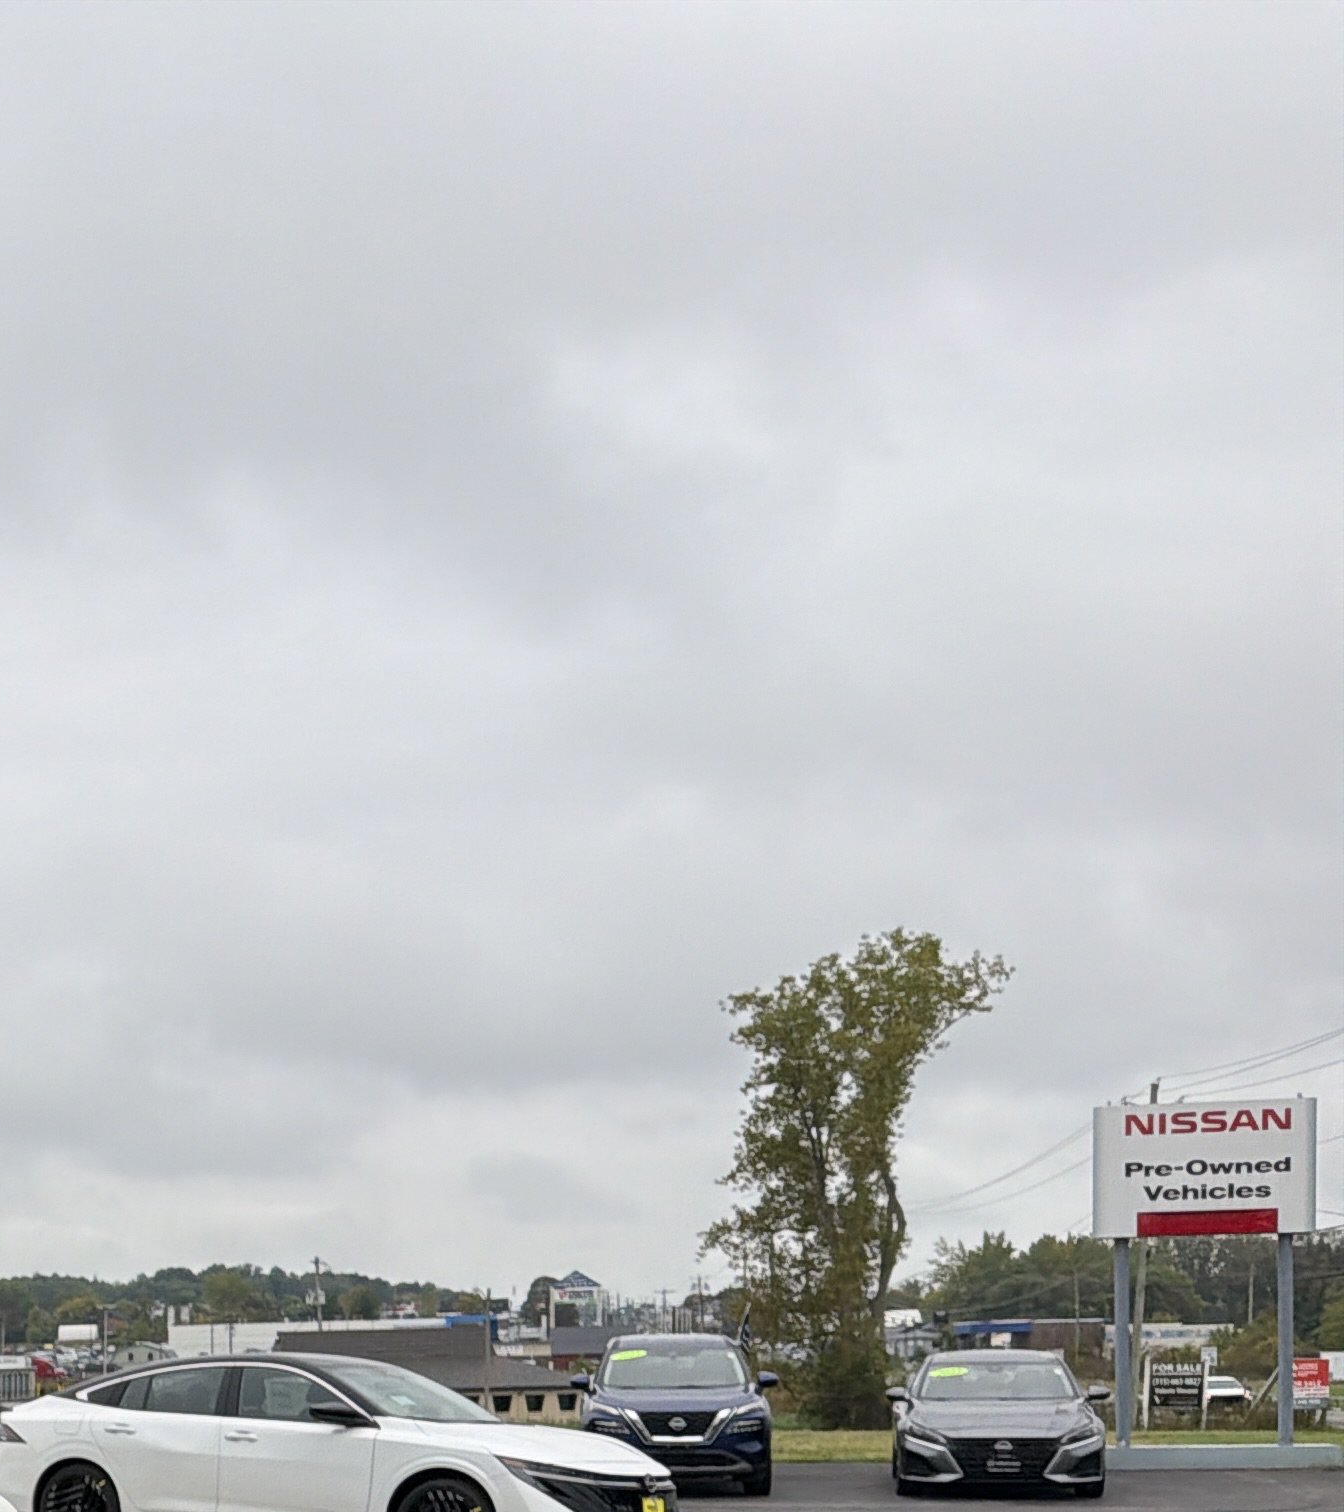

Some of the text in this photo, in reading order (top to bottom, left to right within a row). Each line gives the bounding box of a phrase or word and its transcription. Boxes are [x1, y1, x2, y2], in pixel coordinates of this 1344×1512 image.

[1125, 1107, 1292, 1136] NISSAN
[1125, 1157, 1292, 1178] Pre-Owned
[1144, 1184, 1272, 1202] Vehicles
